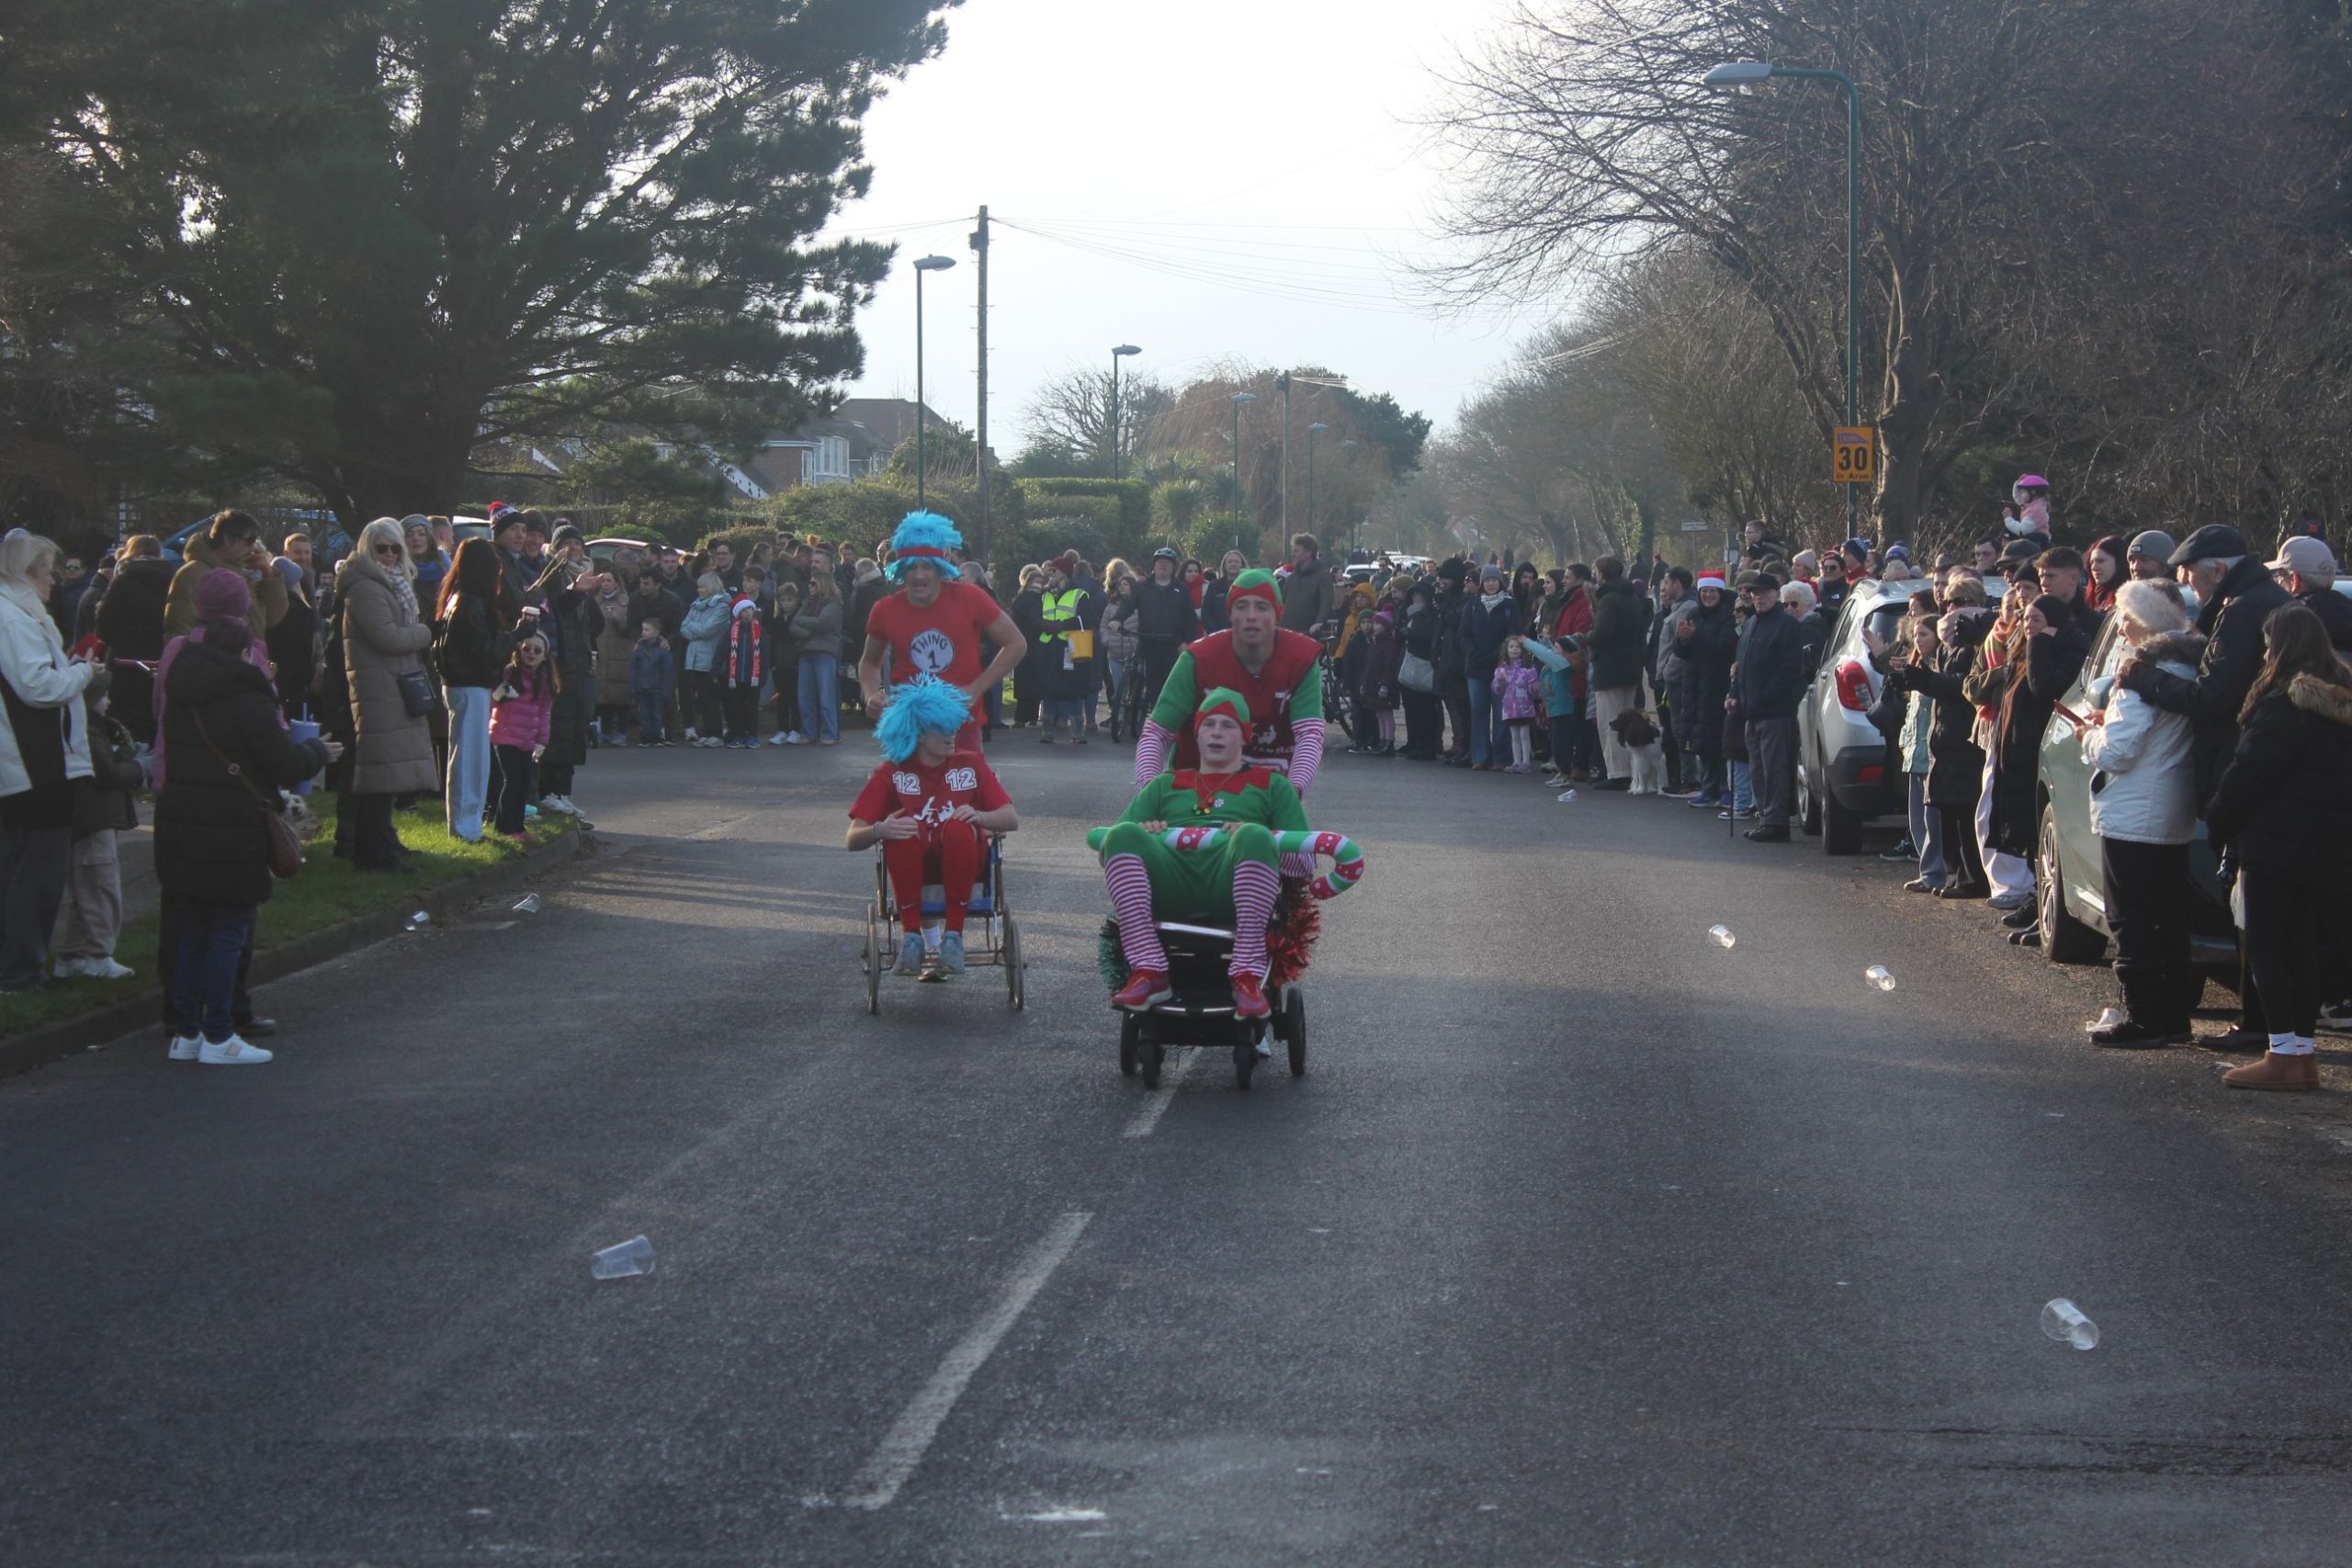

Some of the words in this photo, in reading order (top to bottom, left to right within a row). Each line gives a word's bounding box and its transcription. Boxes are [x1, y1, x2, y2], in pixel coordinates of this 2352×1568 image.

[1838, 446, 1868, 471] 30
[910, 633, 948, 654] THING
[927, 649, 940, 669] 1
[892, 771, 921, 795] 12
[945, 767, 978, 792] 12
